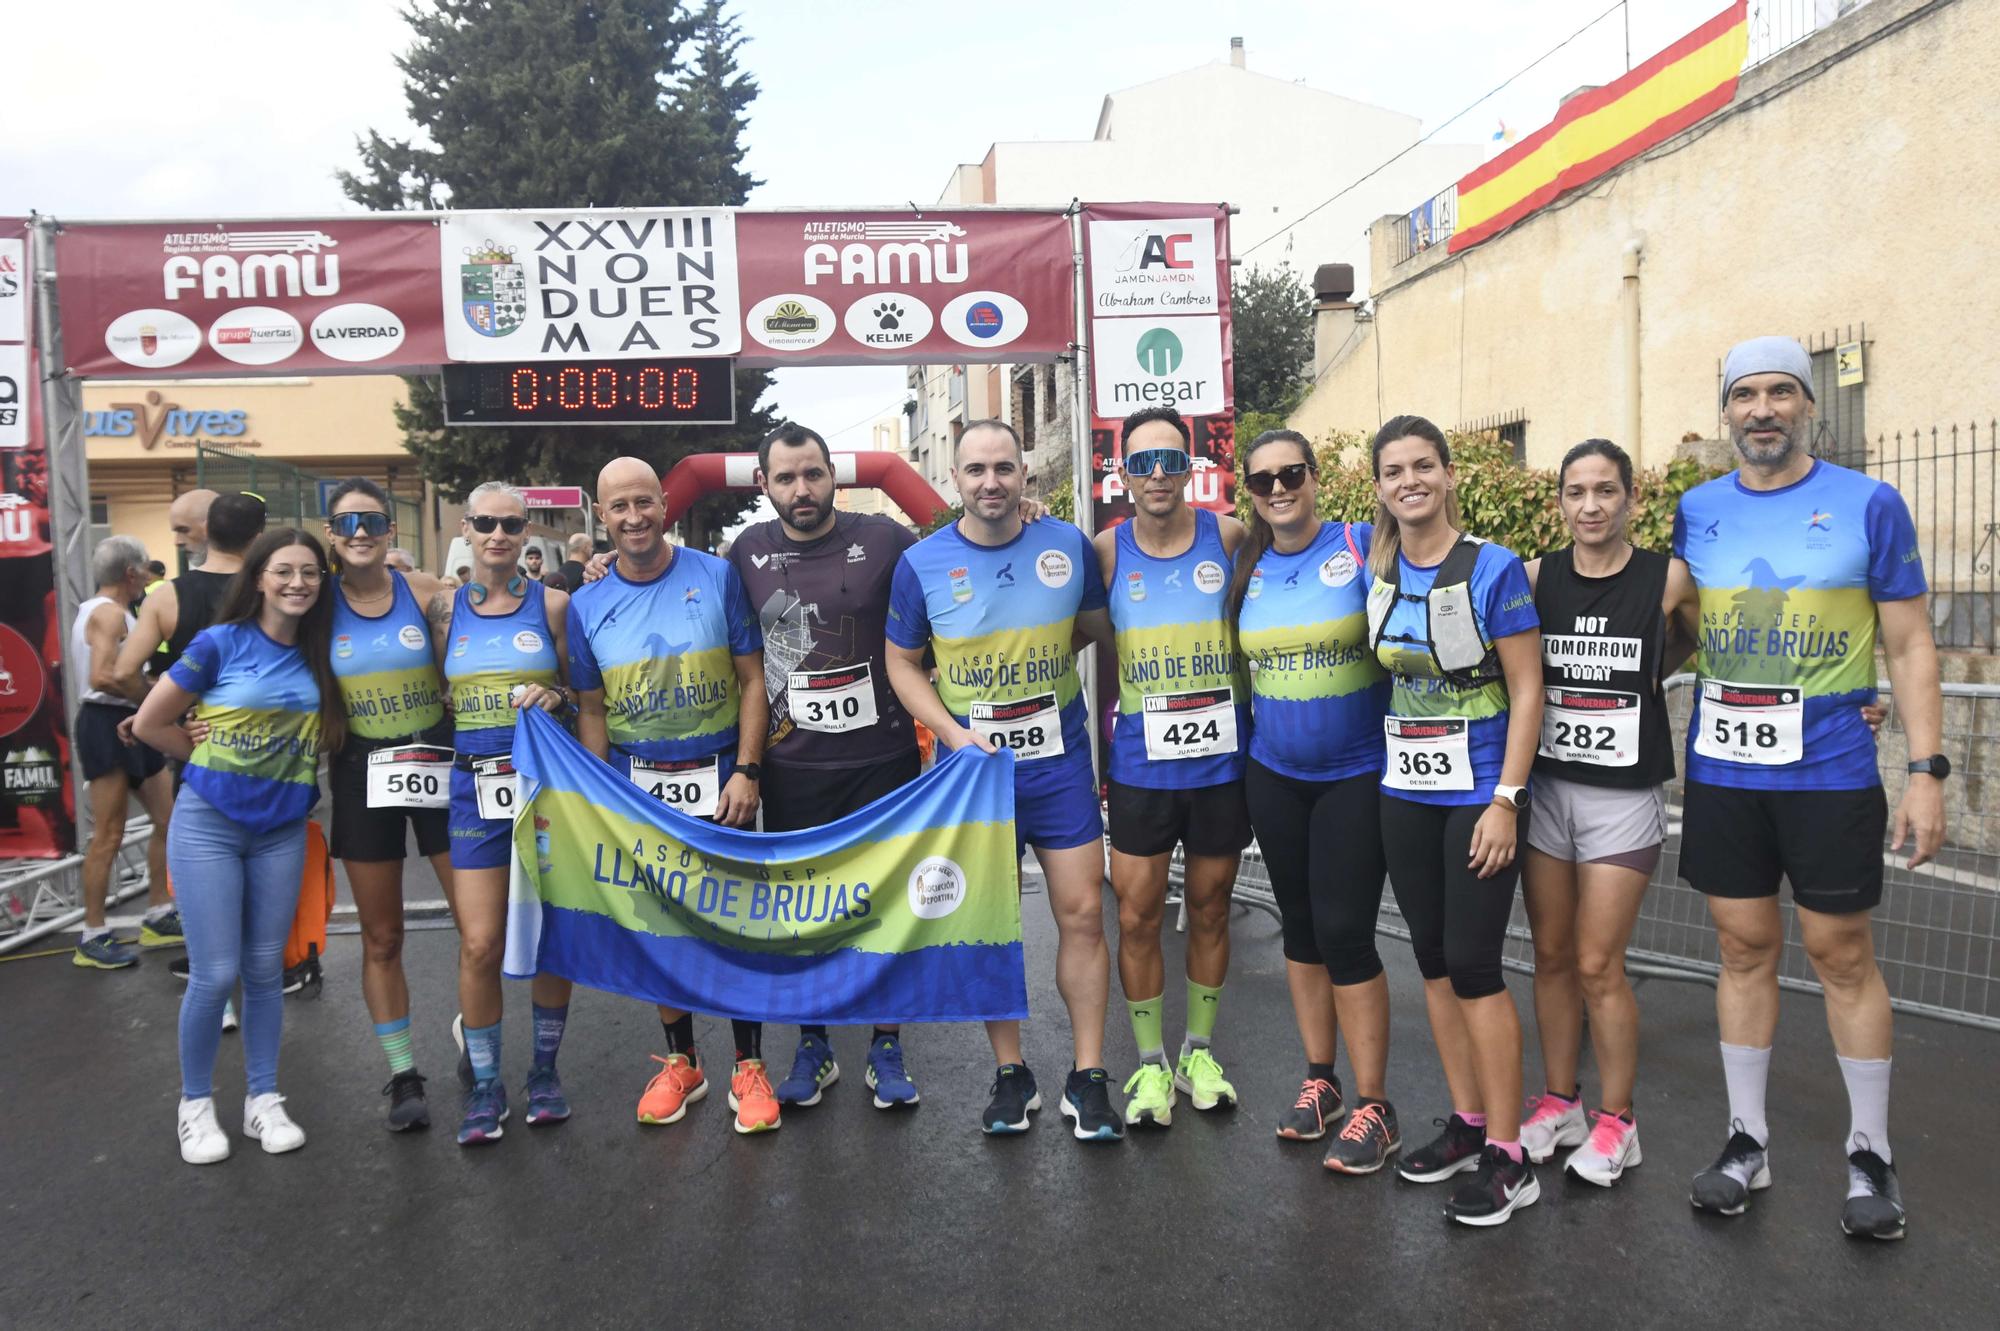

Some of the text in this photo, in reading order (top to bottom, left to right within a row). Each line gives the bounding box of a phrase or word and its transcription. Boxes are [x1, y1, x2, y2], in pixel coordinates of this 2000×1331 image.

[163, 232, 228, 245] ATLETISMO
[533, 217, 712, 250] XXVIII
[804, 222, 865, 232] ATLETISMO
[804, 233, 829, 242] Región
[201, 244, 228, 252] Murcia
[1139, 234, 1194, 269] AC
[538, 251, 715, 285] NON
[804, 242, 969, 285] FAMU
[163, 252, 341, 300] FAMU
[541, 285, 721, 319] DUER
[1099, 291, 1212, 306] Abraham Cambres
[316, 327, 399, 339] LA VERDAD
[541, 318, 721, 353] MAS
[866, 332, 913, 343] KELME
[512, 367, 699, 410] 0:00:00
[1114, 380, 1207, 408] megar
[84, 408, 135, 437] uis
[1102, 473, 1218, 504] FU
[527, 497, 552, 505] Vives
[1574, 616, 1609, 634] NOT
[1543, 638, 1638, 659] TOMORROW
[1735, 628, 1760, 656] DE
[1767, 629, 1850, 659] BRUJAS
[1165, 656, 1187, 679] DE
[1278, 652, 1299, 671] DE
[1303, 643, 1364, 671] BRUJAS
[948, 653, 1075, 689] LLANO DE BRUJAS
[1562, 663, 1614, 682] TODAY
[381, 695, 402, 715] DE
[484, 693, 503, 711] DE
[648, 689, 670, 713] DE
[674, 680, 727, 709] BRUJAS
[1146, 696, 1217, 711] XXVIII NONDUERMAS
[806, 696, 859, 722] 310
[973, 704, 993, 719] XXVIII
[989, 726, 1045, 749] 058
[1163, 719, 1220, 745] 424
[1555, 721, 1616, 751] 282
[1715, 718, 1778, 748] 518
[1177, 747, 1210, 755] JUANCHO
[1566, 752, 1600, 760] ROSARIO
[1399, 751, 1452, 775] 363
[386, 773, 439, 795] 560
[649, 782, 702, 803] 430
[594, 843, 872, 923] LLANO DE BRUJAS
